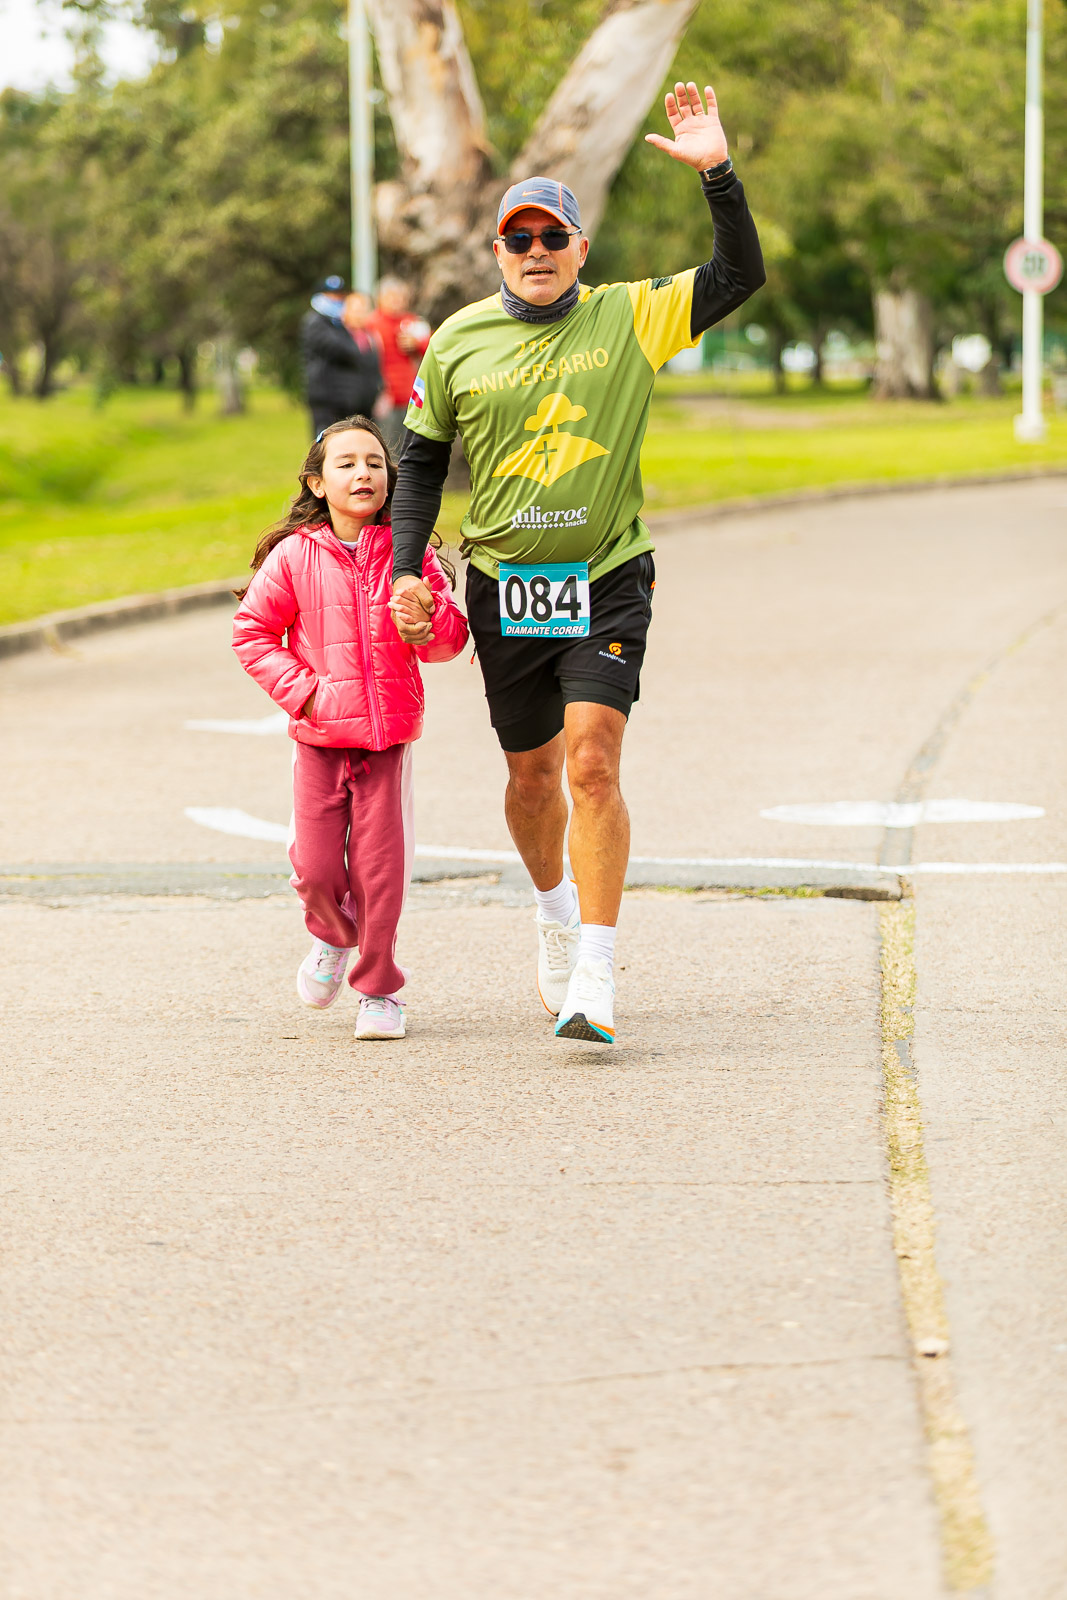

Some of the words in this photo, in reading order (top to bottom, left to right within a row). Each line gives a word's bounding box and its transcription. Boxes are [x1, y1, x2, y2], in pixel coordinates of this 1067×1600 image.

[469, 347, 609, 398] ANIVERSARIO
[565, 519, 588, 527] snacks
[505, 574, 582, 623] 084
[505, 625, 551, 635] DIAMANTE
[551, 625, 586, 635] CORRE
